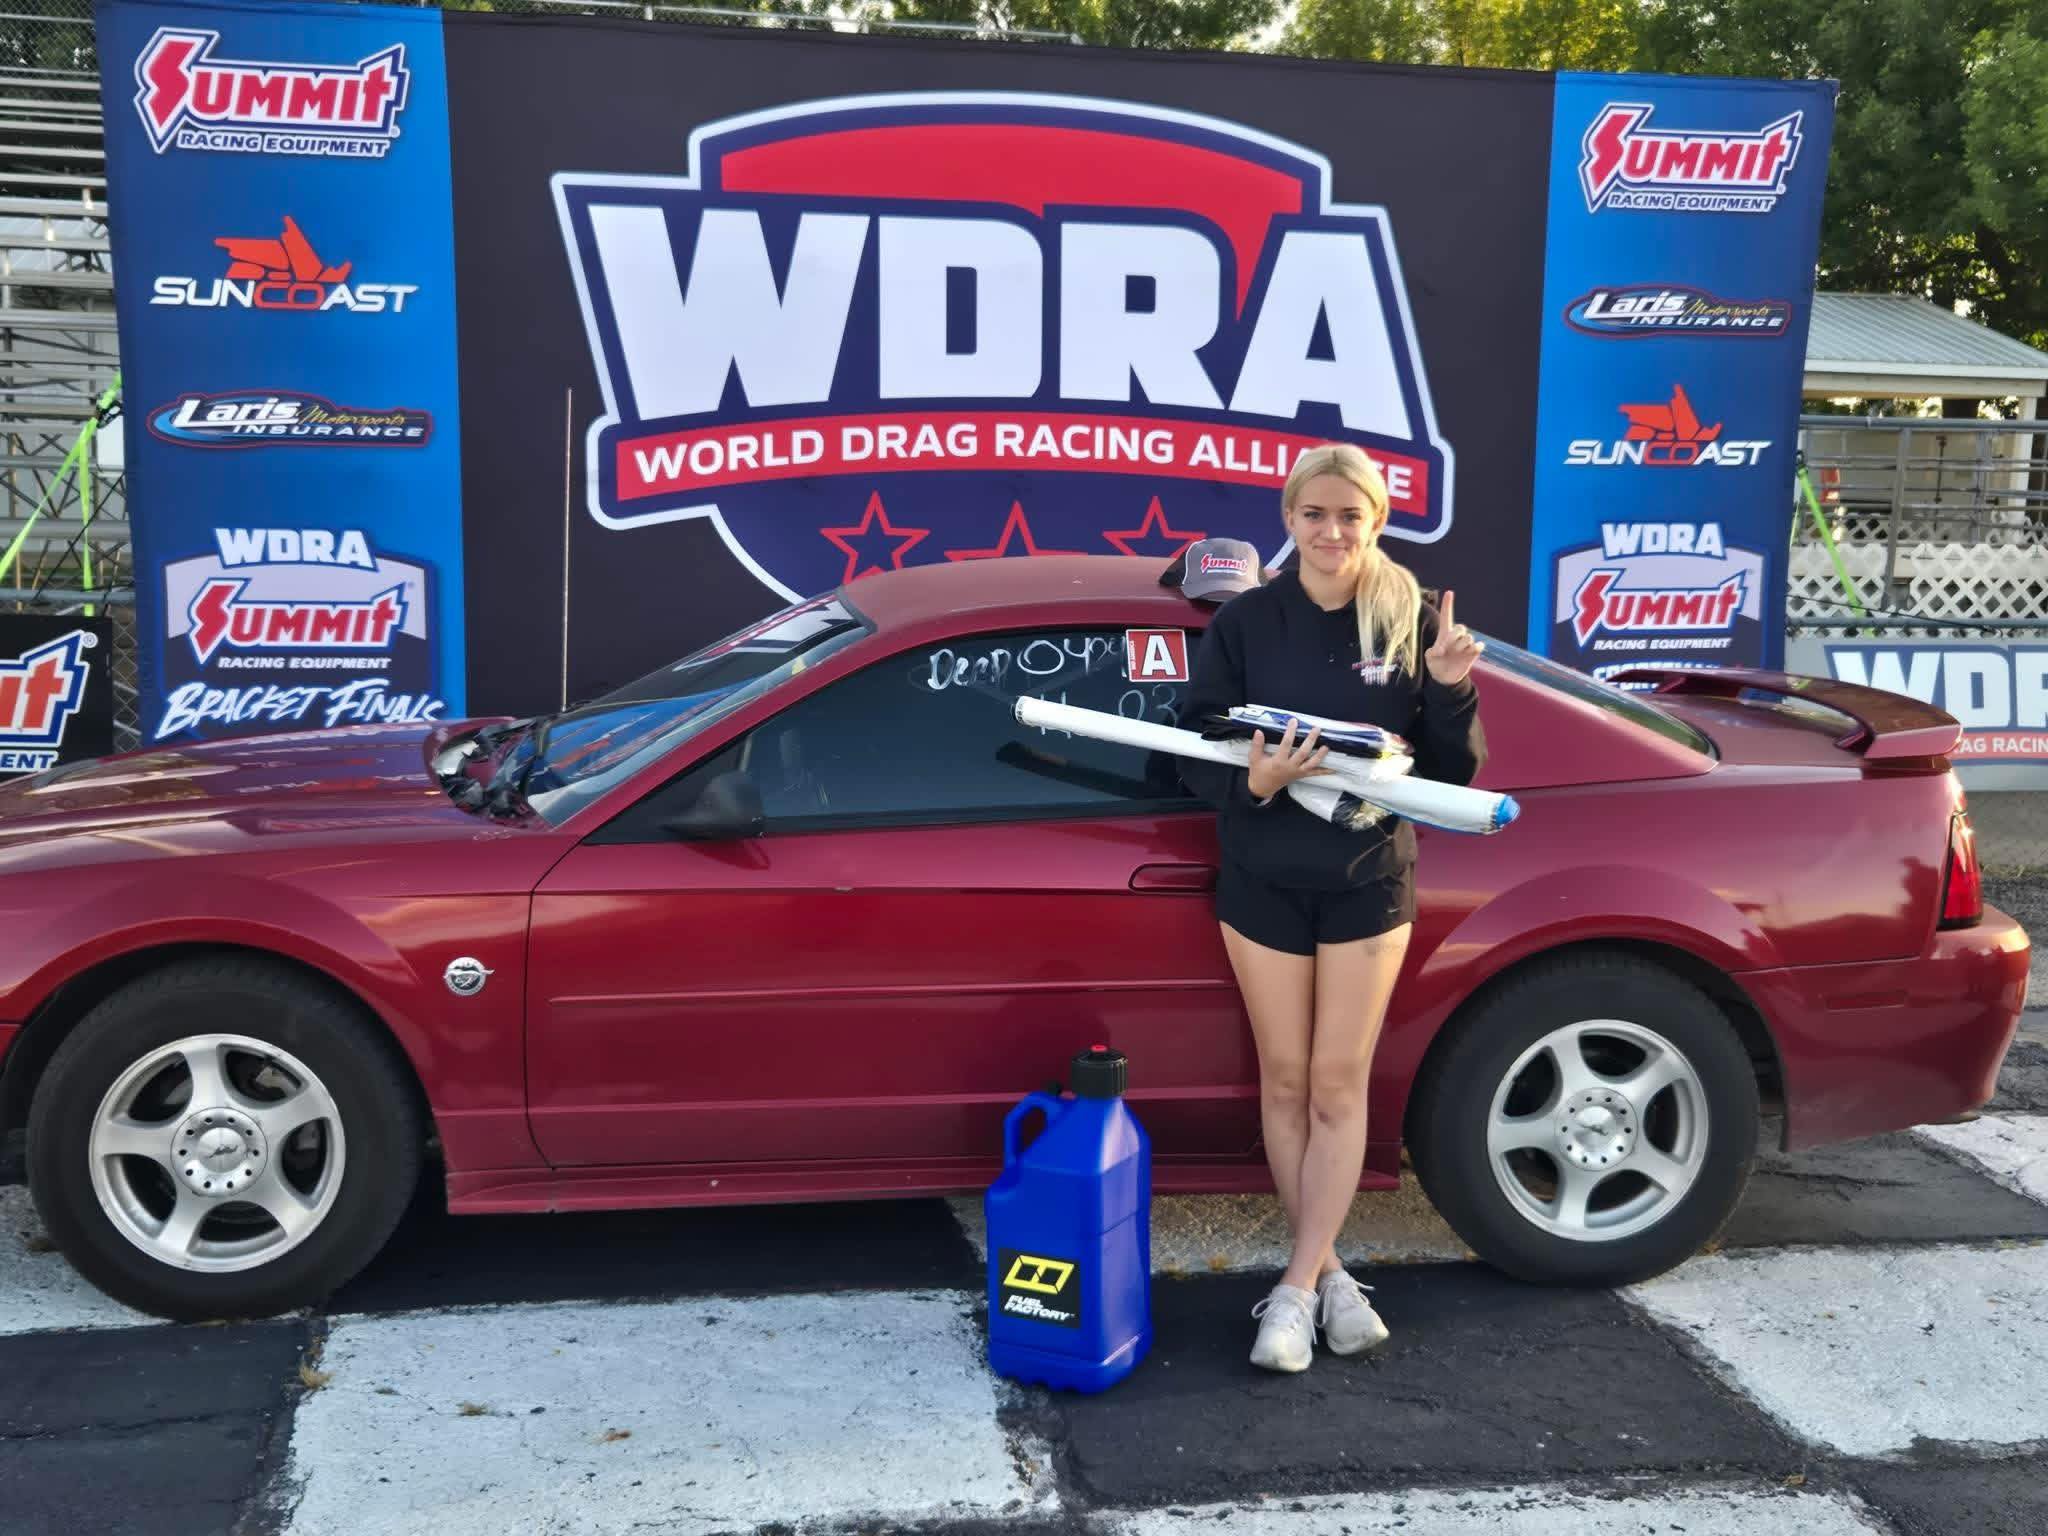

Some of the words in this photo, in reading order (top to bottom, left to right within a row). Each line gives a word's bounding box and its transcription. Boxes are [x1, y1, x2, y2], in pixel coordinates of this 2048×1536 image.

[180, 132, 260, 149] RACING
[265, 136, 389, 156] EQUIPMENT
[1608, 194, 1673, 209] RACING
[1676, 195, 1775, 211] EQUIPMENT
[150, 275, 420, 313] SUNCOAST
[1583, 291, 1688, 319] Laris
[586, 202, 1413, 440] WDRA
[1629, 315, 1783, 327] INSURANCE
[172, 397, 304, 428] Laris
[232, 424, 425, 438] INSURANCE
[634, 429, 826, 484] WORLD
[840, 423, 979, 461] DRAG
[994, 423, 1175, 464] RACING
[1187, 434, 1413, 500] ALLIE
[1563, 440, 1774, 466] SUNCOAST
[215, 527, 375, 567] WDRA
[1602, 523, 1724, 558] WDRA
[1141, 634, 1178, 676] A
[1592, 638, 1647, 651] RACING
[1650, 637, 1732, 650] EQUIPMENT
[217, 656, 286, 670] RACING
[288, 656, 392, 670] EQUIPMENT
[154, 681, 333, 740] BRACKET
[324, 678, 445, 728] FINALS
[1954, 736, 1987, 753] AG
[1003, 1302, 1071, 1321] FACTORY
[1007, 1294, 1043, 1308] FUEL
